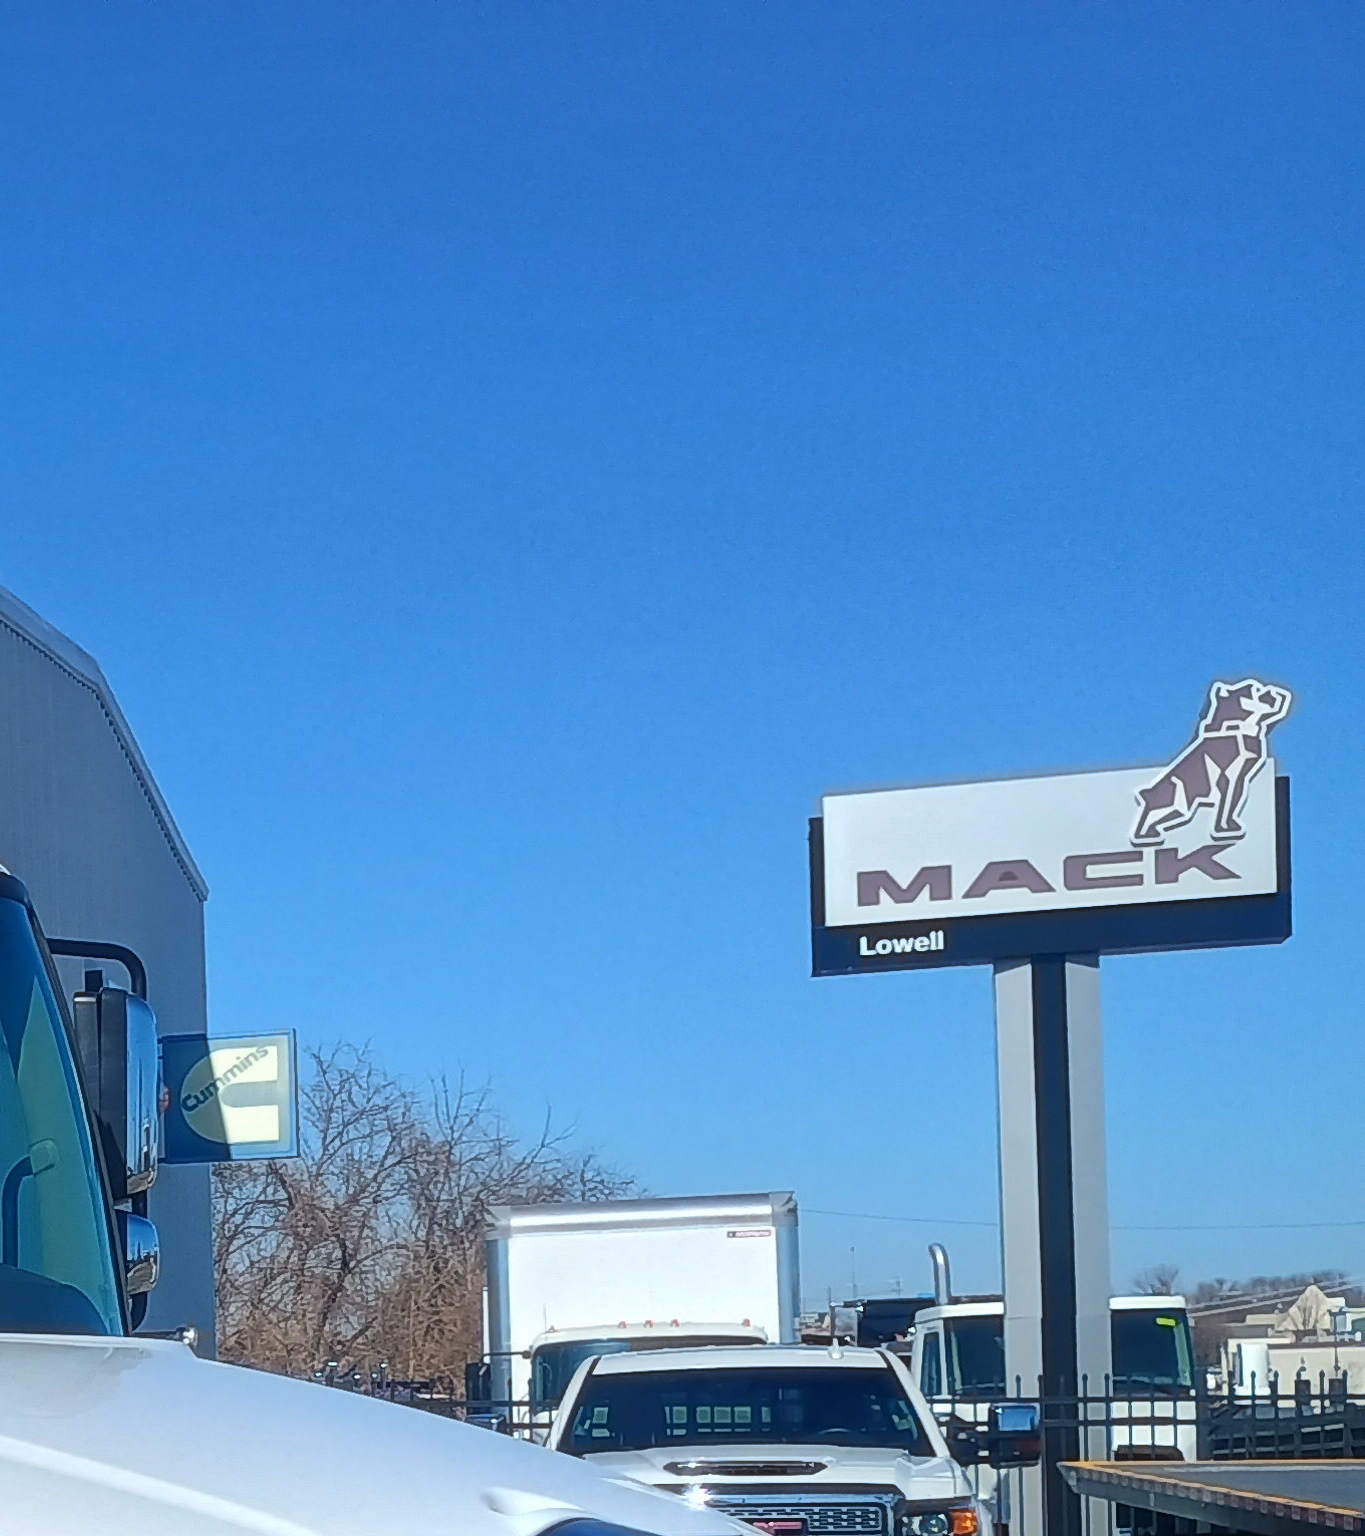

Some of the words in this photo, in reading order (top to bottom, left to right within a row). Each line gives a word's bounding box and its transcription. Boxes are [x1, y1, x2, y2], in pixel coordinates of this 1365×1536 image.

[857, 843, 1242, 907] MACK
[859, 930, 944, 957] Lowell
[180, 1045, 269, 1112] Cummins
